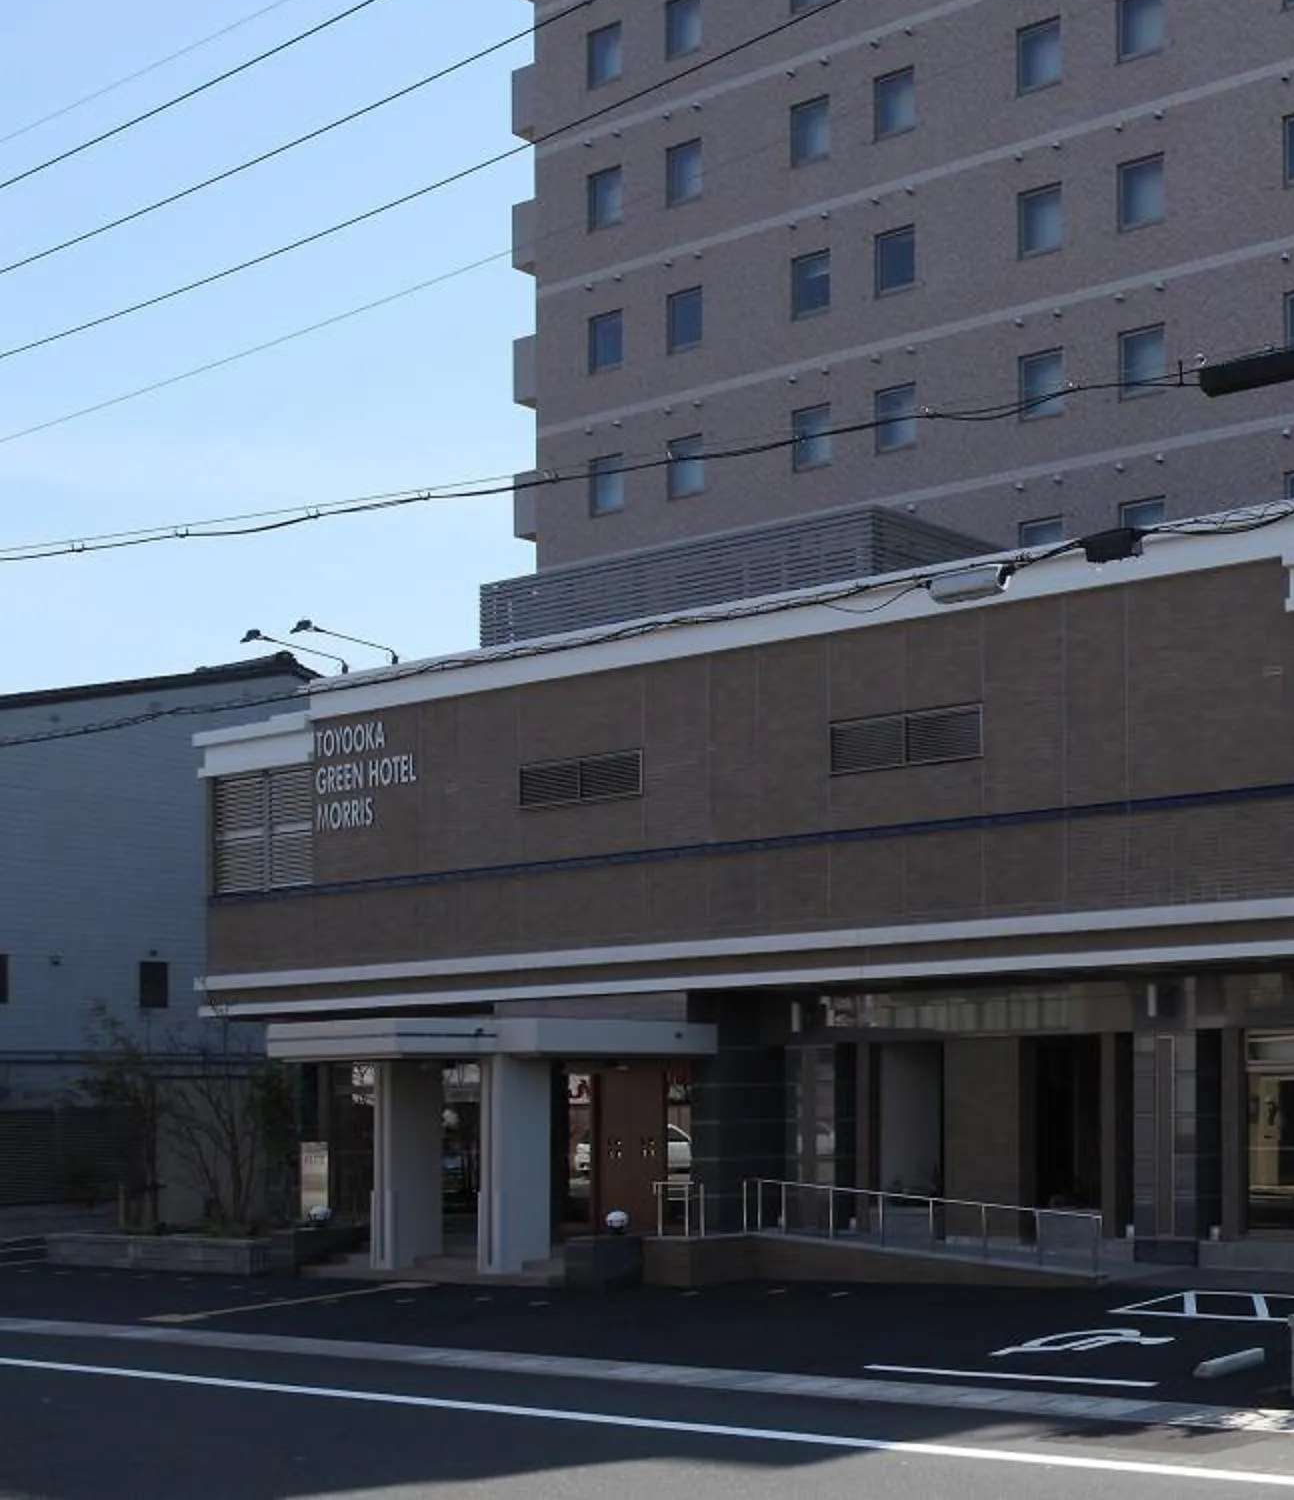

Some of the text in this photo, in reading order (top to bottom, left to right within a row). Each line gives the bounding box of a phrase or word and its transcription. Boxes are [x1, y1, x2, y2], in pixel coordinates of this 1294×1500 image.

[316, 721, 385, 757] TOYOOKA
[315, 753, 417, 795] GREEN HOTEL
[316, 797, 374, 832] MORRIS
